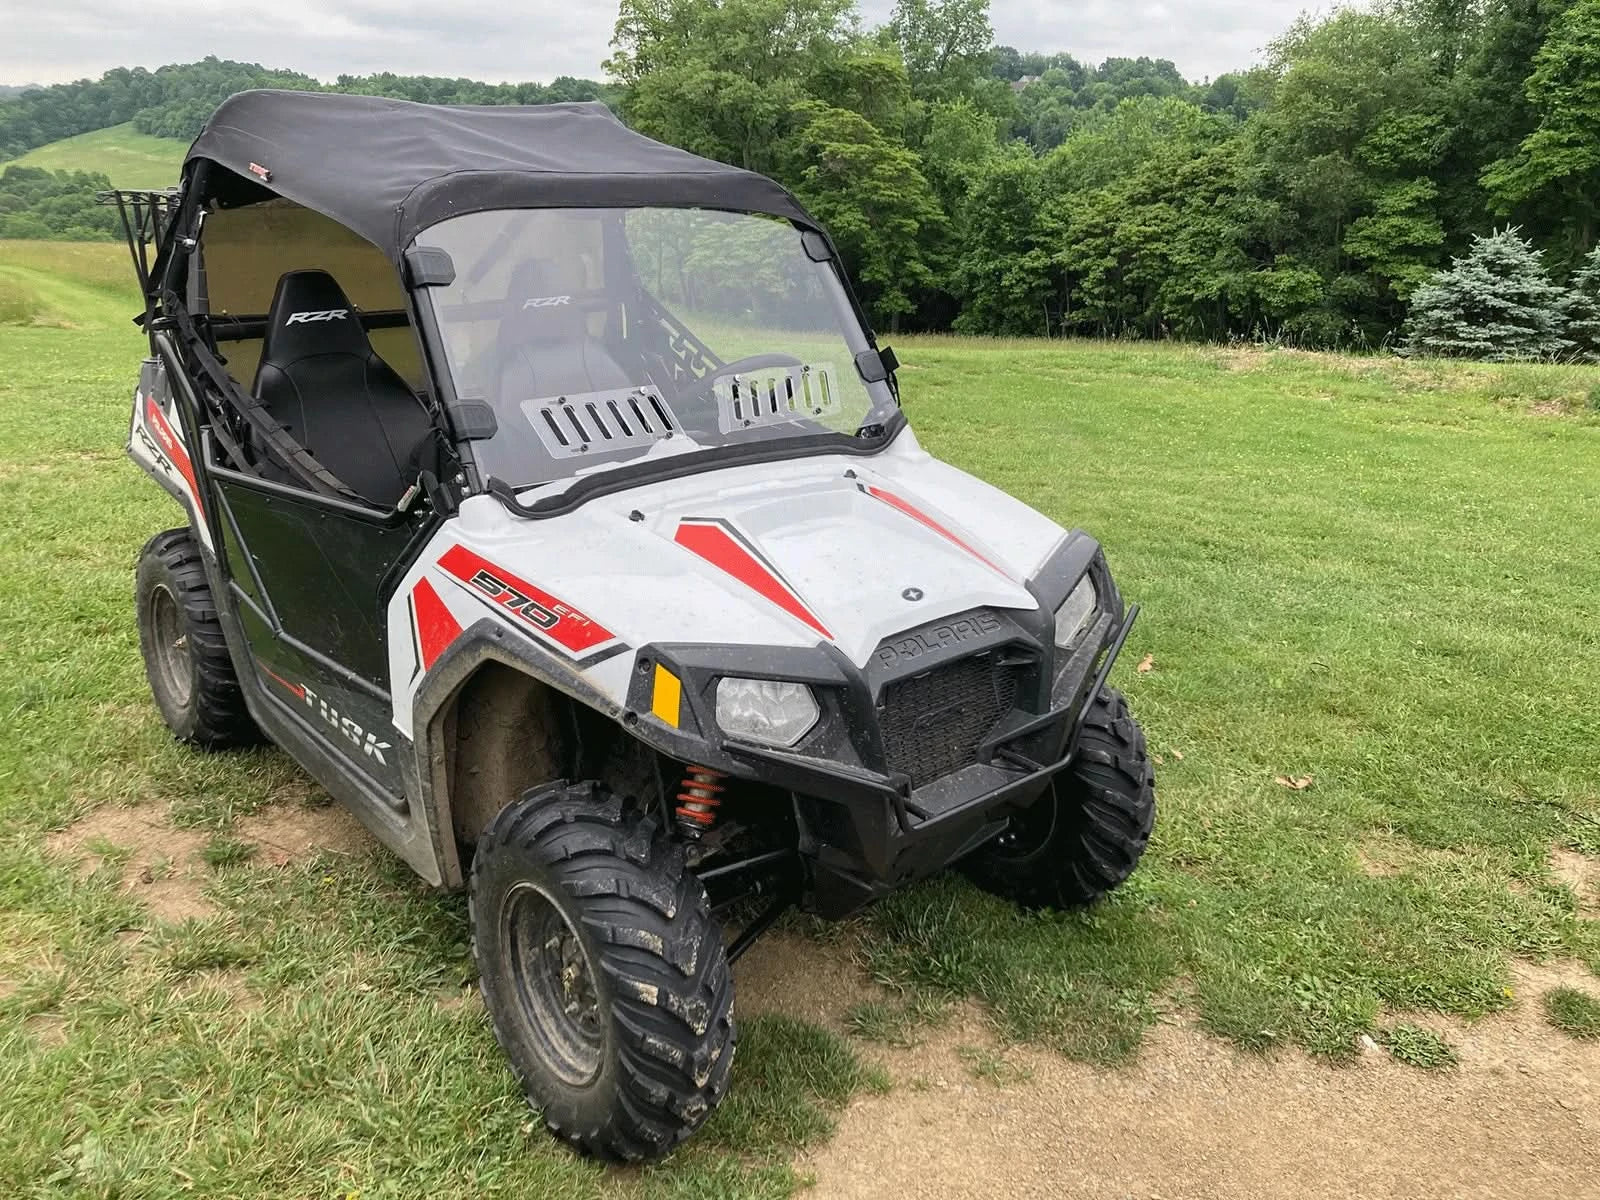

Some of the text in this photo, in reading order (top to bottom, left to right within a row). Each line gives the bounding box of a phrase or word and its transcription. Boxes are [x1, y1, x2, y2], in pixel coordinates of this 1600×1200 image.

[285, 309, 349, 327] RZR
[521, 295, 570, 310] RZR
[135, 424, 172, 475] RZR
[470, 569, 591, 630] 570 EFI
[875, 612, 1001, 672] POLARIS
[300, 683, 392, 767] TUSK
